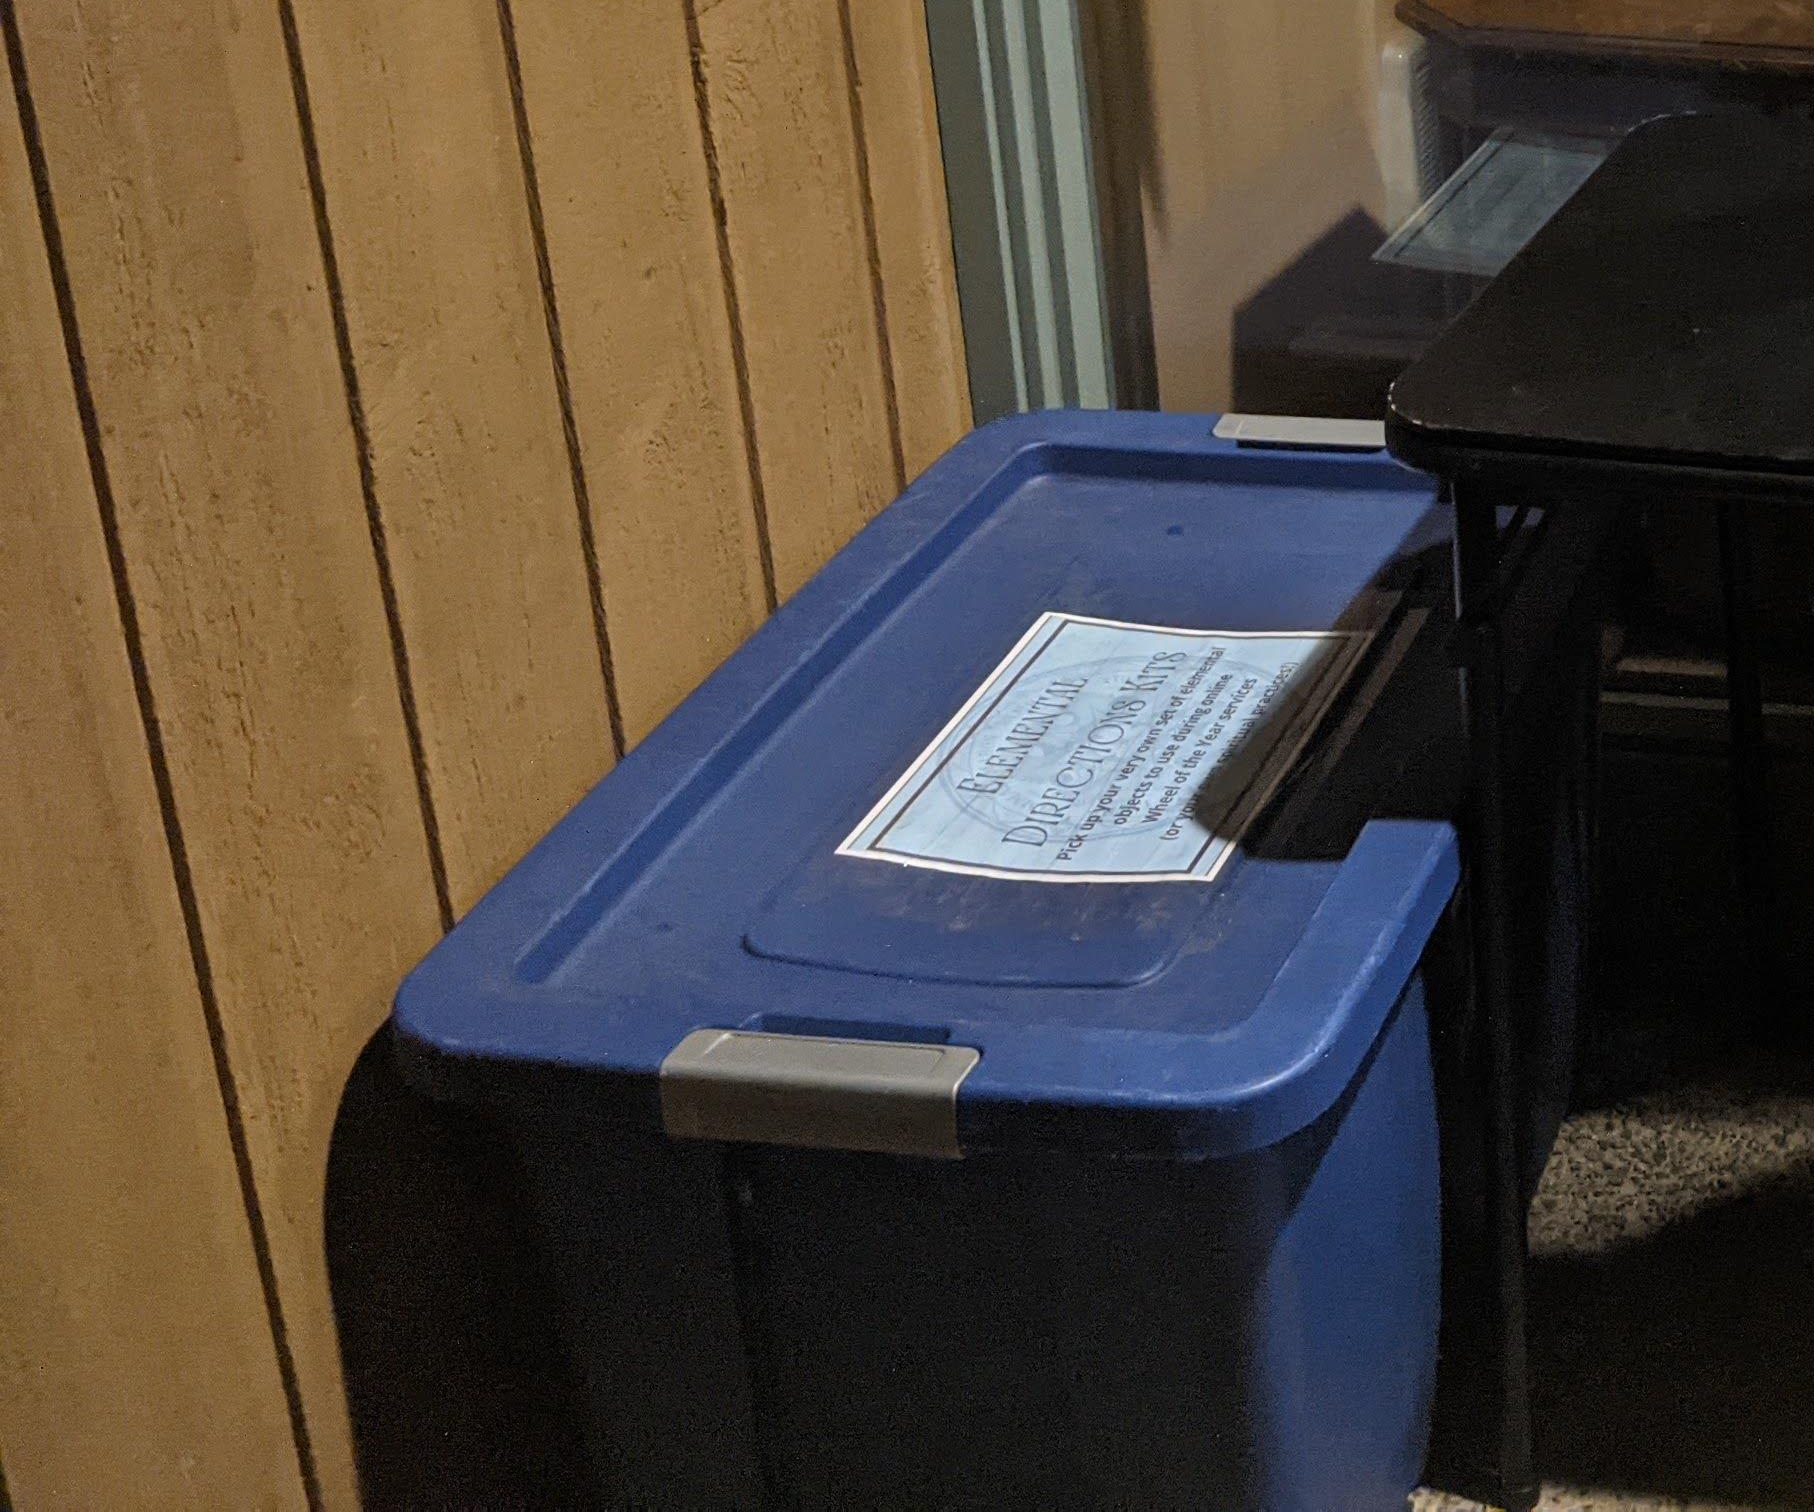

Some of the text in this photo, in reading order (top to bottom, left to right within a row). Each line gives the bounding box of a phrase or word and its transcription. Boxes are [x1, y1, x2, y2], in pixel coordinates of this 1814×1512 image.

[1057, 647, 1226, 860] Pick up your very own set of elemental
[1114, 779, 1152, 824] objects
[1148, 764, 1161, 779] to
[1159, 743, 1178, 766] use
[1173, 707, 1212, 743] during
[1203, 674, 1232, 709] online
[1143, 785, 1180, 823] Wheel
[1174, 769, 1189, 783] of
[1183, 749, 1206, 770] the
[1198, 724, 1225, 750] Year
[1219, 678, 1257, 723] services
